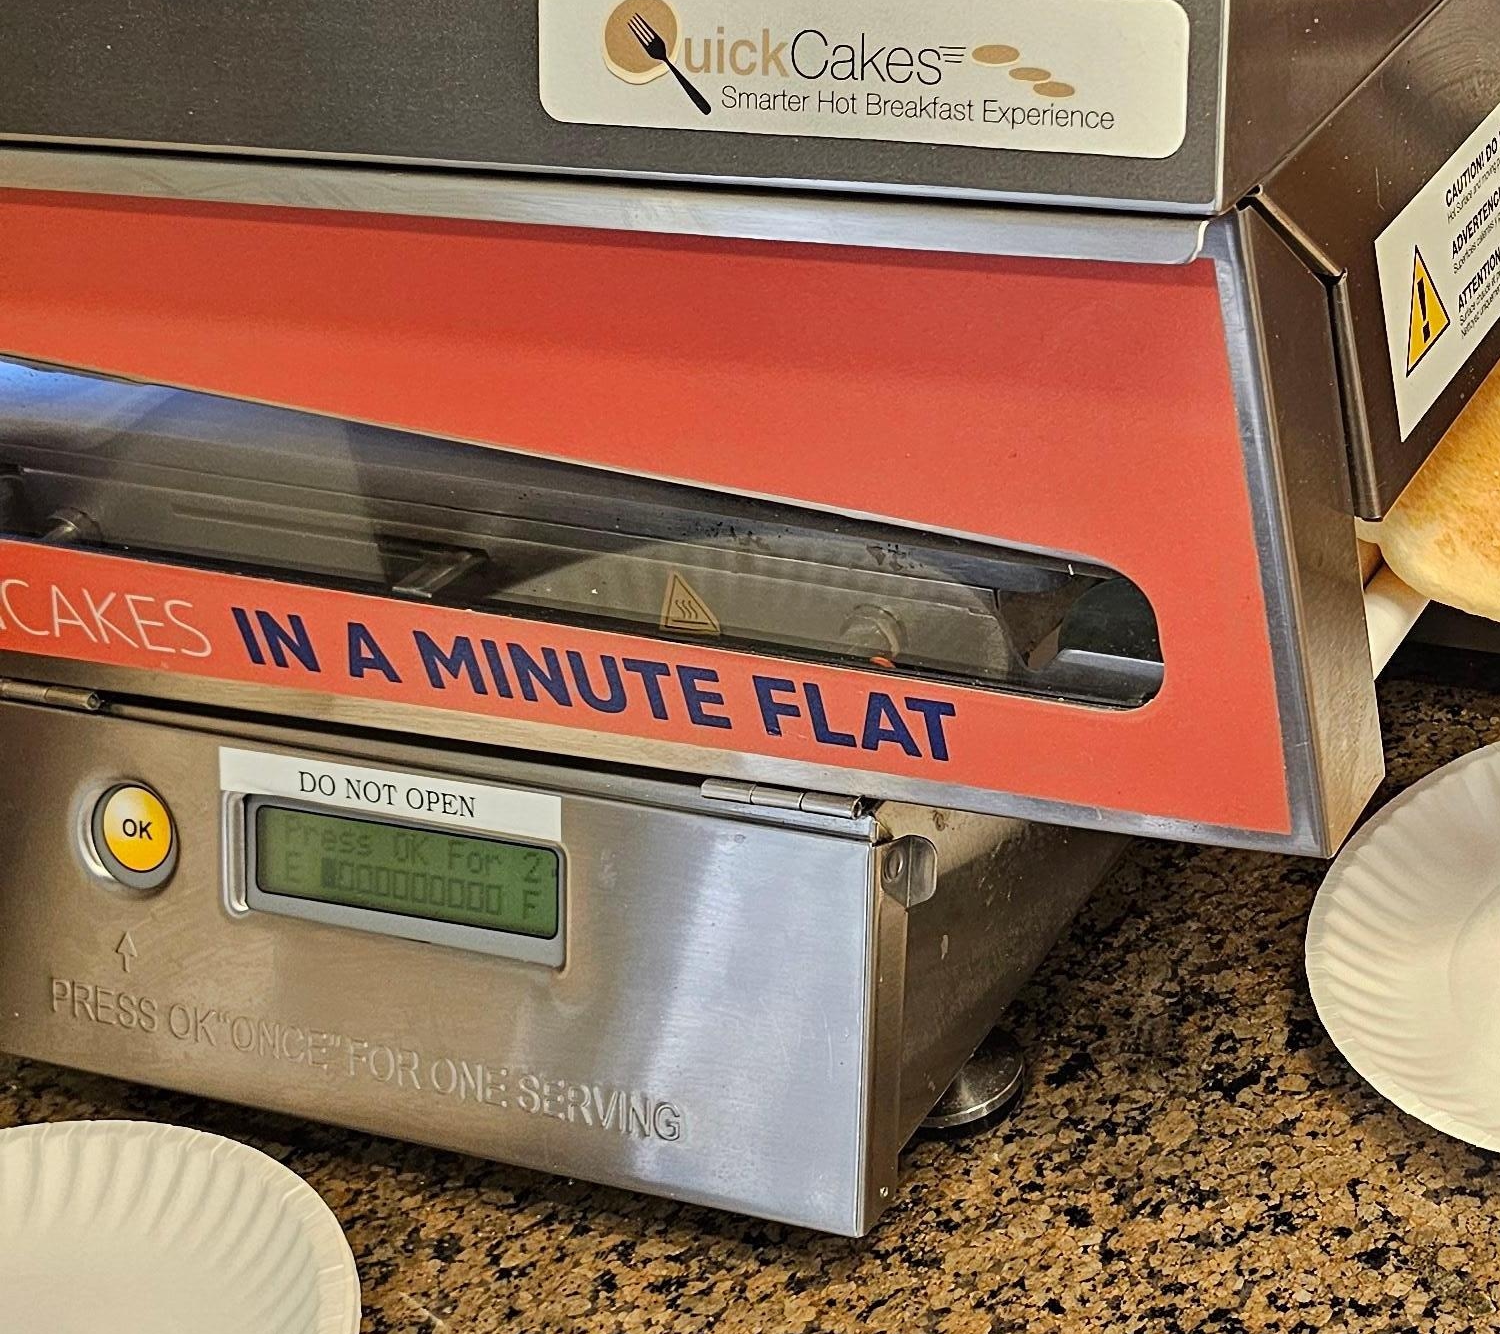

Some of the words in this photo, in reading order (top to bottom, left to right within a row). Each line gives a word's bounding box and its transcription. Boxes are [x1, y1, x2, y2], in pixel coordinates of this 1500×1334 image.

[720, 84, 810, 113] Smarter
[817, 90, 858, 114] Hot
[866, 93, 975, 123] Breakfast
[981, 98, 1116, 130] Experience
[1445, 154, 1484, 209] CAUTION!
[1485, 134, 1497, 163] DO
[0, 578, 213, 658] CAKES
[231, 607, 321, 672] IN
[347, 621, 403, 684] A
[412, 629, 733, 731] MINUTE
[751, 674, 957, 763] FLAT
[298, 770, 337, 797] DO
[344, 777, 399, 807] NOT
[405, 786, 477, 818] OPEN
[122, 818, 154, 841] OK
[50, 977, 159, 1034] PRESS
[348, 1037, 422, 1090] FOR
[430, 1057, 508, 1109] ONE
[516, 1074, 682, 1142] SERVING
